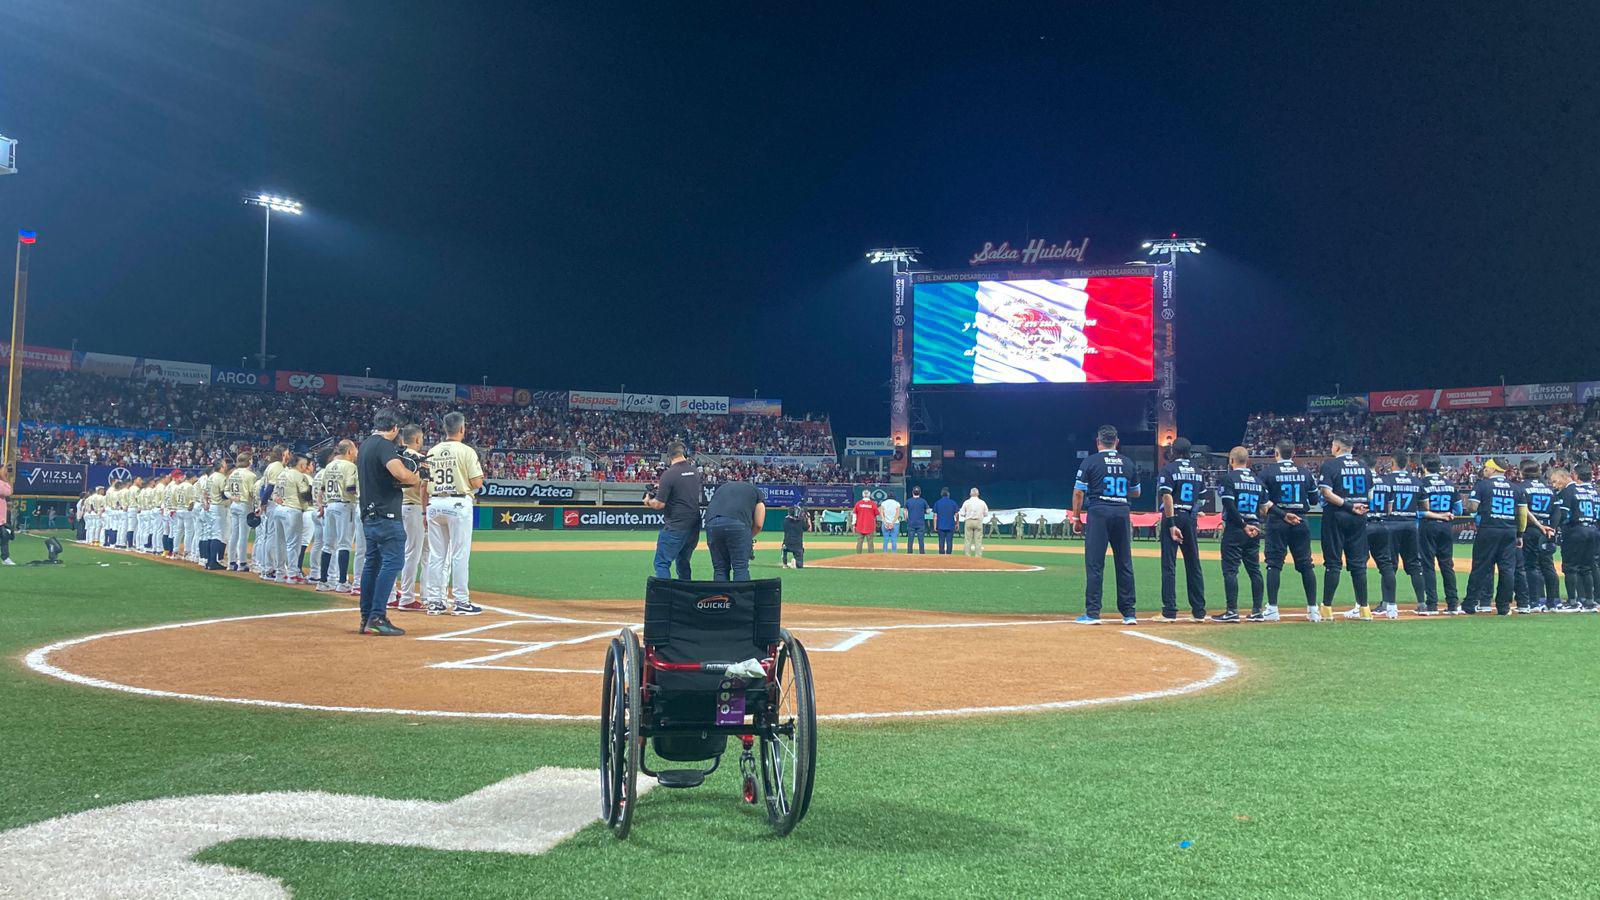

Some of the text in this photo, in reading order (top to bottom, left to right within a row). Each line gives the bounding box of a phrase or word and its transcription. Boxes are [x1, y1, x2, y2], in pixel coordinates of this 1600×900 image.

[969, 237, 1090, 265] Salsa Huichol
[217, 371, 256, 385] ARCO
[288, 374, 325, 389] exa
[400, 383, 451, 395] dportenis
[1529, 385, 1570, 394] LARSSON
[570, 394, 618, 407] Gaspasa
[1528, 392, 1574, 401] ELEVATOR
[688, 399, 727, 411] debate
[859, 439, 885, 447] Chevron
[432, 461, 457, 469] RIVERA
[41, 470, 82, 480] VIZSLA
[435, 468, 454, 485] 36
[488, 484, 573, 498] Banco Azteca
[1103, 476, 1128, 497] 30
[1181, 482, 1194, 502] 6
[1342, 476, 1366, 494] 49
[1281, 483, 1300, 503] 31
[1492, 489, 1514, 497] VALLE
[1237, 492, 1259, 513] 25
[1396, 493, 1413, 511] 17
[1430, 494, 1451, 511] 26
[1491, 496, 1515, 515] 52
[1531, 494, 1551, 512] 57
[1579, 501, 1594, 517] 48
[511, 512, 533, 523] Carl's
[580, 511, 665, 525] caliente.mx
[697, 601, 731, 609] QUICKIE
